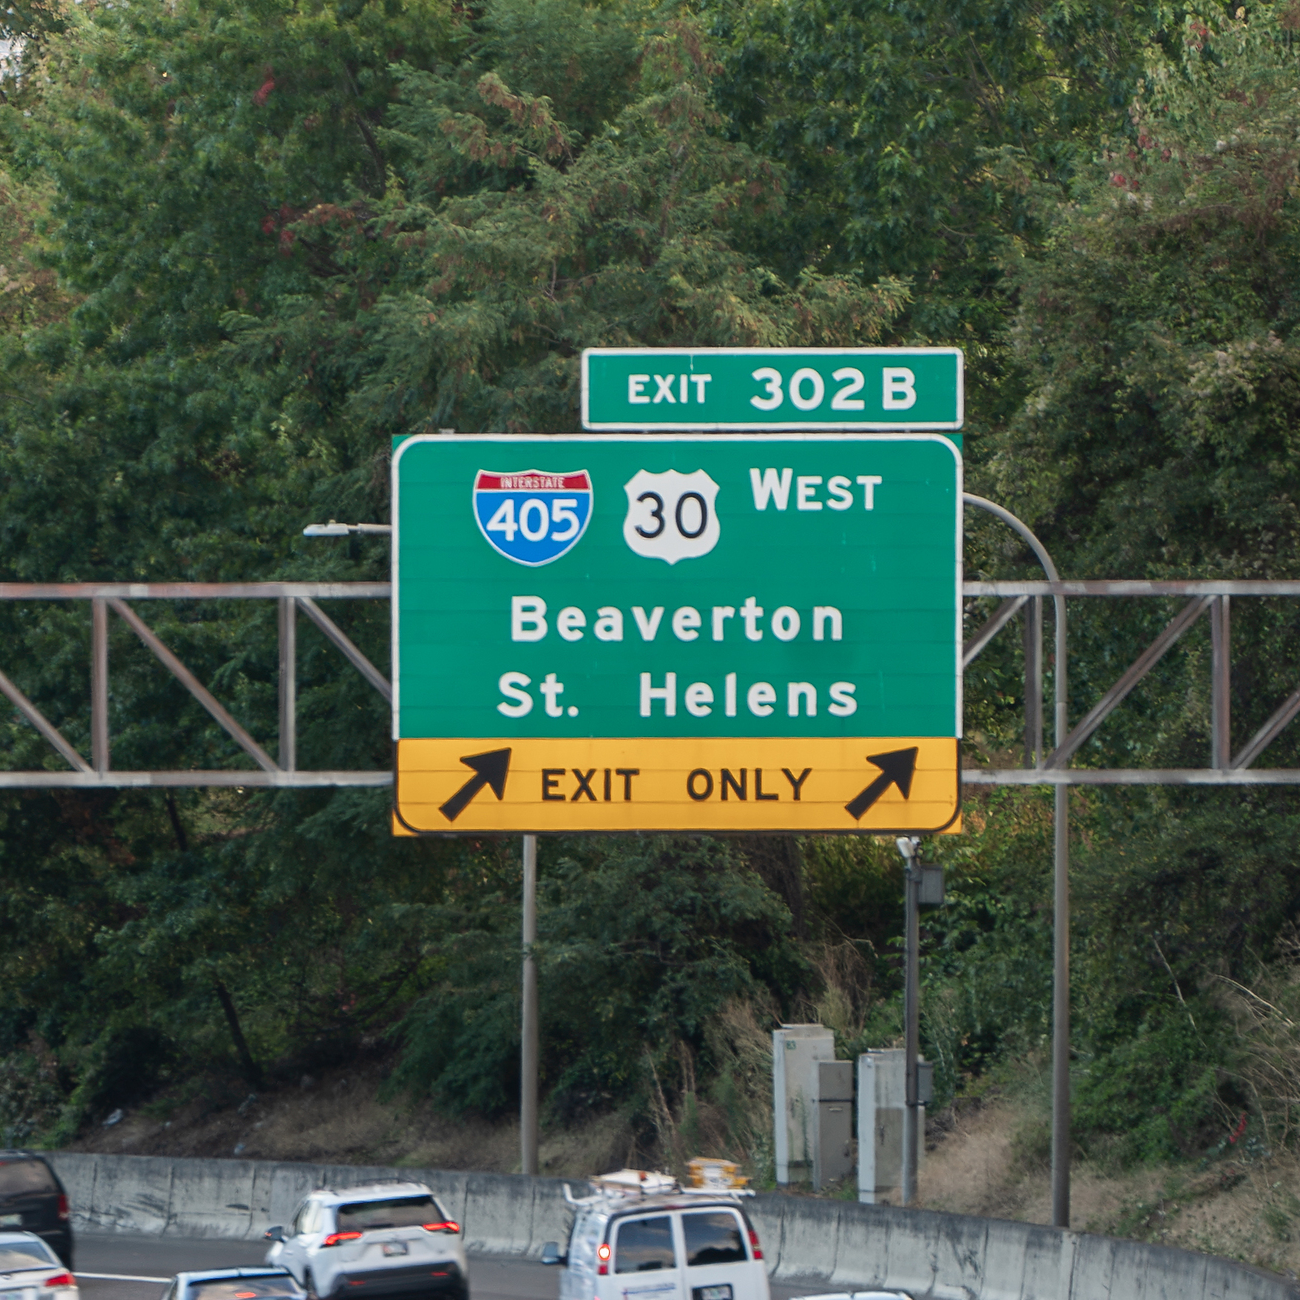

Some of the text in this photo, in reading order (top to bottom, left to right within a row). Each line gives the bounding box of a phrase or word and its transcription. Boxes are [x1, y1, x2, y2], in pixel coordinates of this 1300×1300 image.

[628, 373, 712, 404] EXIT
[500, 475, 566, 489] INTERSTATE
[749, 467, 883, 511] WEST
[485, 498, 581, 542] 405
[634, 491, 708, 539] 30
[511, 595, 843, 642] Beaverton
[497, 671, 858, 718] St. Helens
[541, 767, 813, 802] EXIT ONLY
